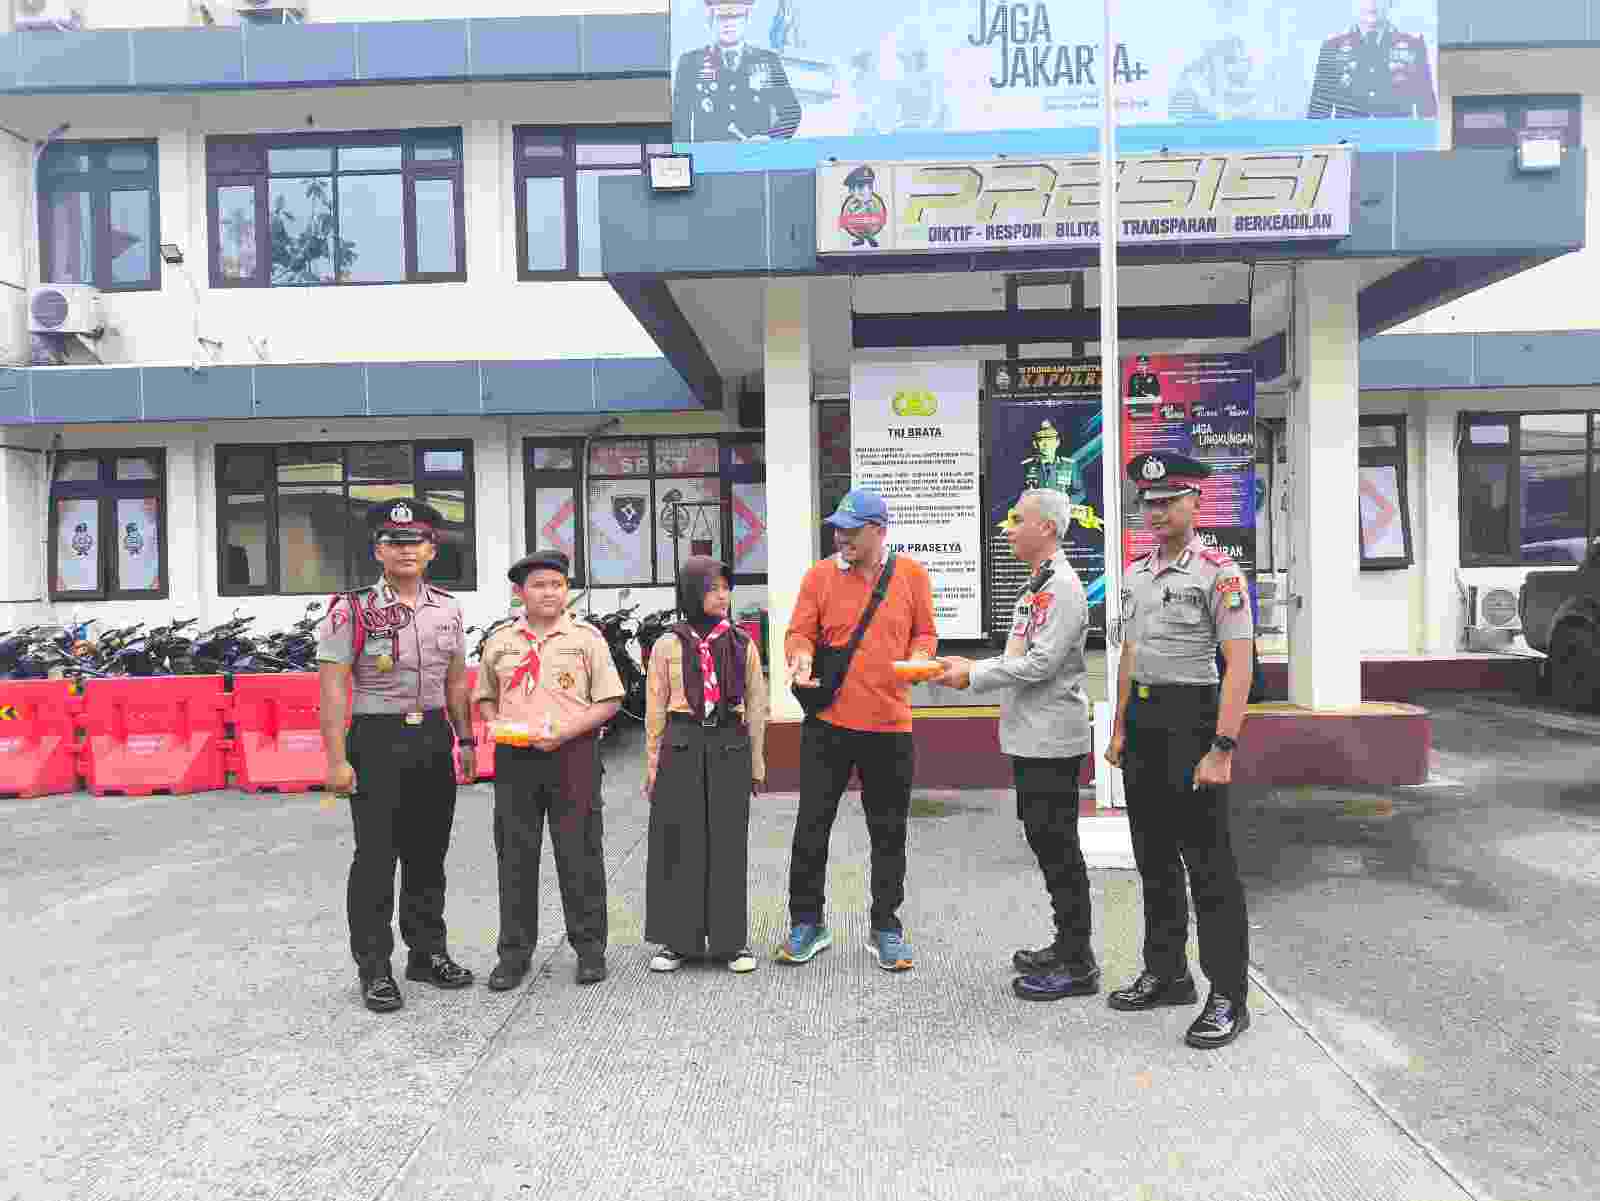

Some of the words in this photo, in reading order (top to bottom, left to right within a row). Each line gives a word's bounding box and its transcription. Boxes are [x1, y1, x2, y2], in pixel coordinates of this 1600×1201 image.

[968, 0, 1050, 46] JAGA
[989, 40, 1150, 88] JAKARA+
[1234, 213, 1332, 231] BERKEADILAN
[907, 427, 942, 437] BRATA
[908, 543, 962, 552] PRASETYA
